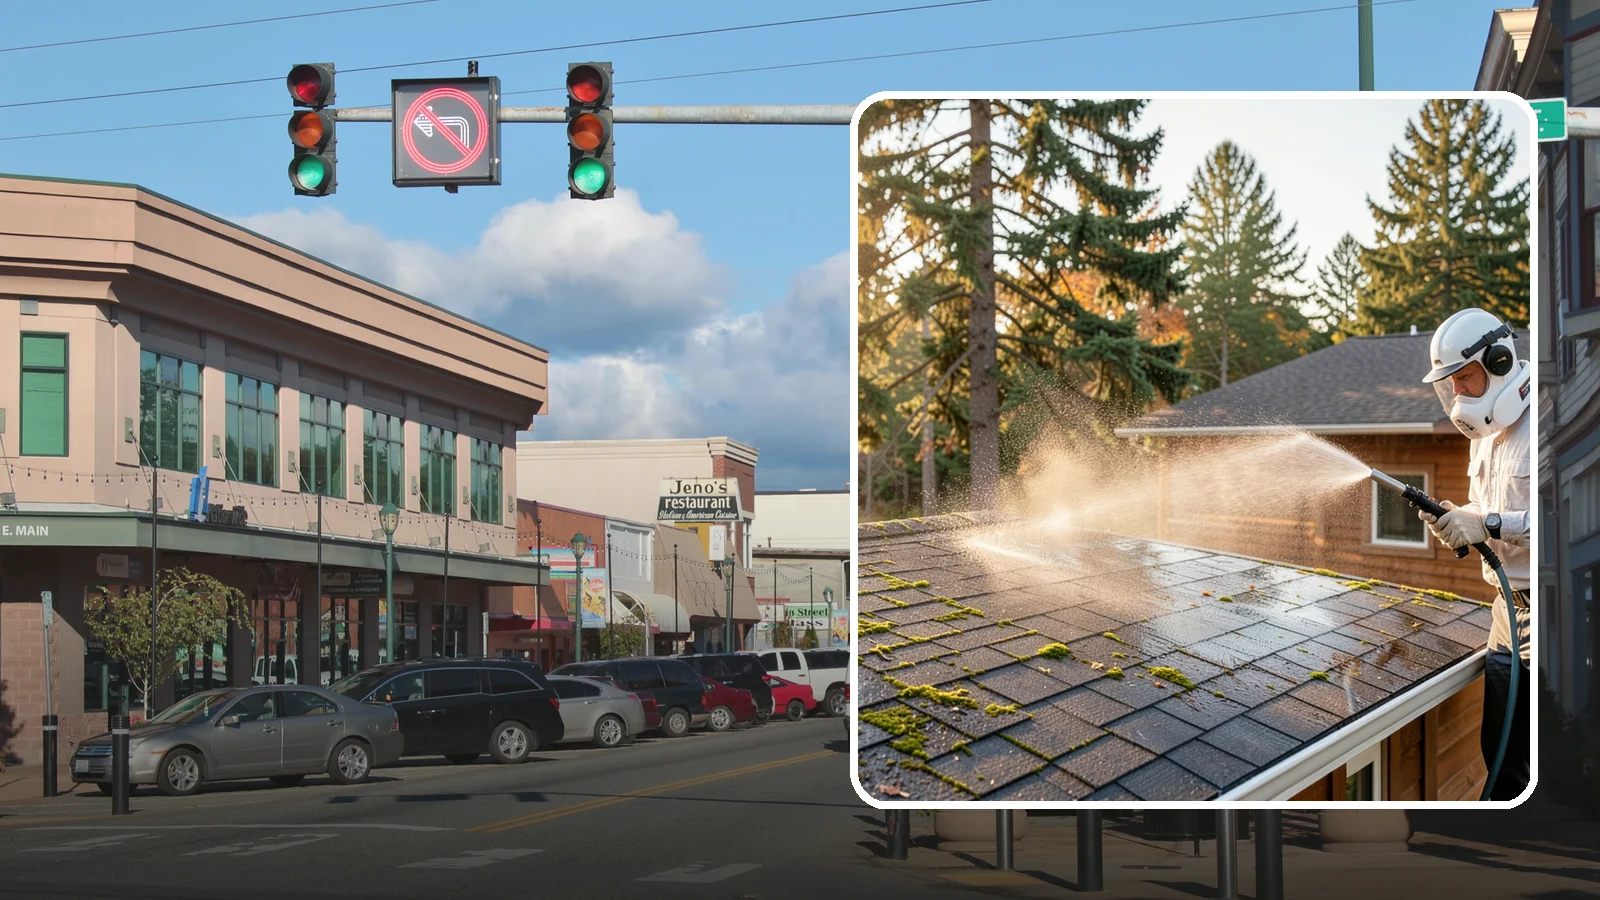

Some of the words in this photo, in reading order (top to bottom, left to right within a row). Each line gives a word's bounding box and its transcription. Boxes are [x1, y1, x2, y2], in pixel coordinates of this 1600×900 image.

[670, 480, 727, 494] Jeno's
[665, 496, 731, 509] restaurant
[686, 509, 714, 519] American
[715, 509, 737, 519] Cuisine
[2, 525, 13, 536] E.
[15, 525, 49, 536] MAIN
[797, 608, 828, 617] Street
[790, 619, 823, 627] lass
